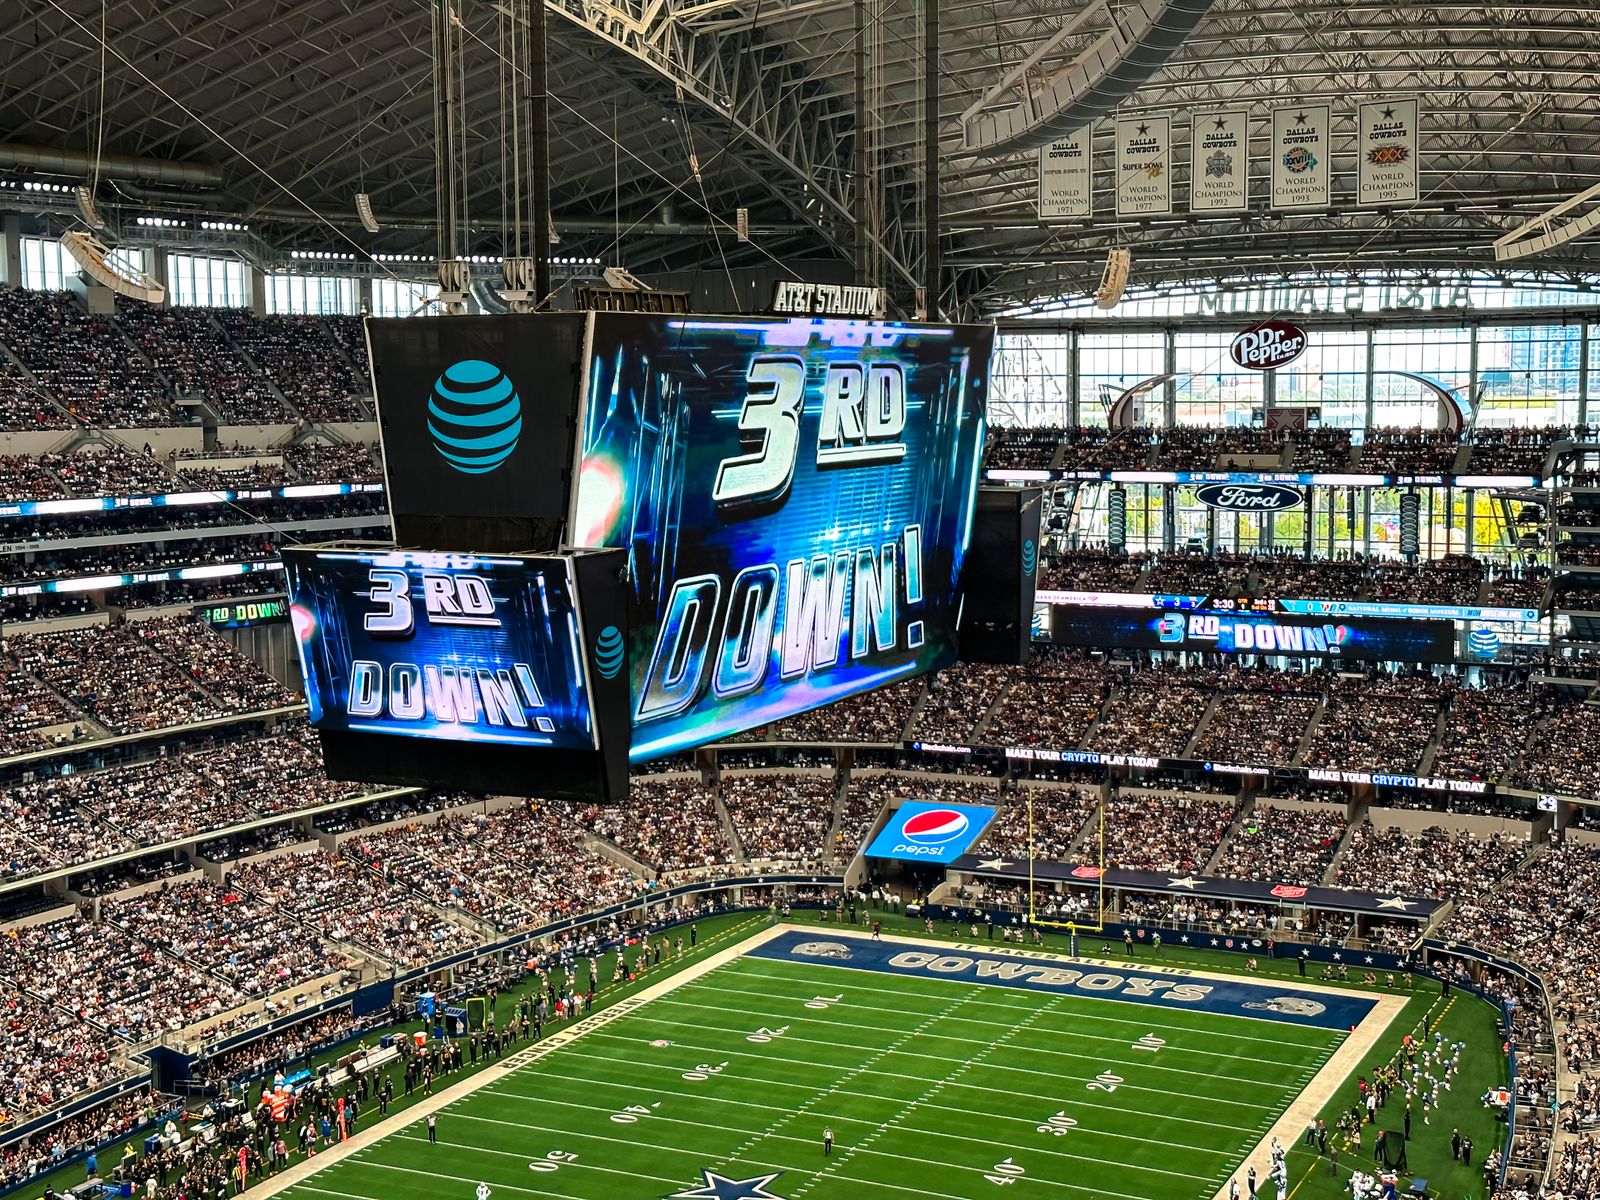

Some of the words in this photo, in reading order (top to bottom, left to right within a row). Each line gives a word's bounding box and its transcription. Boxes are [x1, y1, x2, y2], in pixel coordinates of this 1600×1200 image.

[1286, 127, 1315, 136] DALLAS
[1373, 122, 1403, 131] DALLAS
[1283, 135, 1319, 144] COWBOYS
[1369, 130, 1407, 140] COWBOYS
[1129, 138, 1157, 146] DALLAS
[1202, 140, 1237, 149] COWBOYS
[1049, 150, 1081, 158] COWBOYS
[1126, 145, 1160, 154] COWBOYS
[1374, 149, 1402, 162] XXX
[1122, 163, 1142, 171] SUPER
[1285, 177, 1316, 185] WORLD
[1372, 173, 1404, 181] WORLD
[1204, 181, 1234, 189] WORLD
[1275, 186, 1325, 195] CHAMPIONS
[1362, 181, 1414, 191] CHAMPIONS
[1120, 193, 1166, 203] CHAMPIONS
[1195, 190, 1243, 198] CHAMPIONS
[1291, 195, 1310, 203] 1993
[1379, 191, 1398, 200] 1995
[1043, 198, 1087, 206] CHAMPIONS
[1135, 202, 1152, 210] 1977
[1057, 206, 1073, 214] 1971
[773, 281, 815, 313] AT&T
[816, 284, 878, 315] STADIUM
[1257, 328, 1285, 348] Dr
[1232, 332, 1302, 364] Pepper
[1216, 485, 1281, 508] Ford
[1174, 597, 1180, 606] 3
[1213, 599, 1234, 609] 3:30
[1307, 603, 1313, 611] 0
[634, 524, 925, 721] DOWN!
[1234, 624, 1341, 653] DOWN!
[347, 661, 555, 733] DOWN!
[921, 743, 972, 754] Blockchain.com
[1006, 748, 1034, 759] MAKE
[1035, 750, 1060, 761] YOUR
[1061, 752, 1099, 763] CRYPTO
[1100, 756, 1125, 765] PLAY
[1127, 757, 1159, 768] TODAY
[1213, 763, 1269, 775] Blockchain.com
[1308, 769, 1340, 781] MAKE
[1341, 772, 1371, 784] YOUR
[1372, 774, 1416, 787] CRYPTO
[1417, 778, 1446, 790] PLAY
[1448, 780, 1486, 792] TODAY
[1539, 795, 1557, 811] 29
[892, 844, 945, 855] pepsi
[988, 947, 1066, 961] TAKES
[1068, 956, 1113, 967] ALL
[1161, 966, 1193, 976] US
[888, 952, 1214, 1001] COWBOYS
[804, 994, 838, 1009] 10
[564, 998, 646, 1037] INTERCEPT
[746, 1027, 785, 1044] 20
[1132, 1035, 1166, 1053] 10
[499, 1037, 569, 1069] CANCER
[682, 1063, 723, 1082] 30
[1086, 1073, 1124, 1093] 20
[610, 1104, 652, 1124] 40
[1036, 1115, 1078, 1137] 30
[528, 1150, 580, 1173] 50
[983, 1163, 1026, 1186] 40
